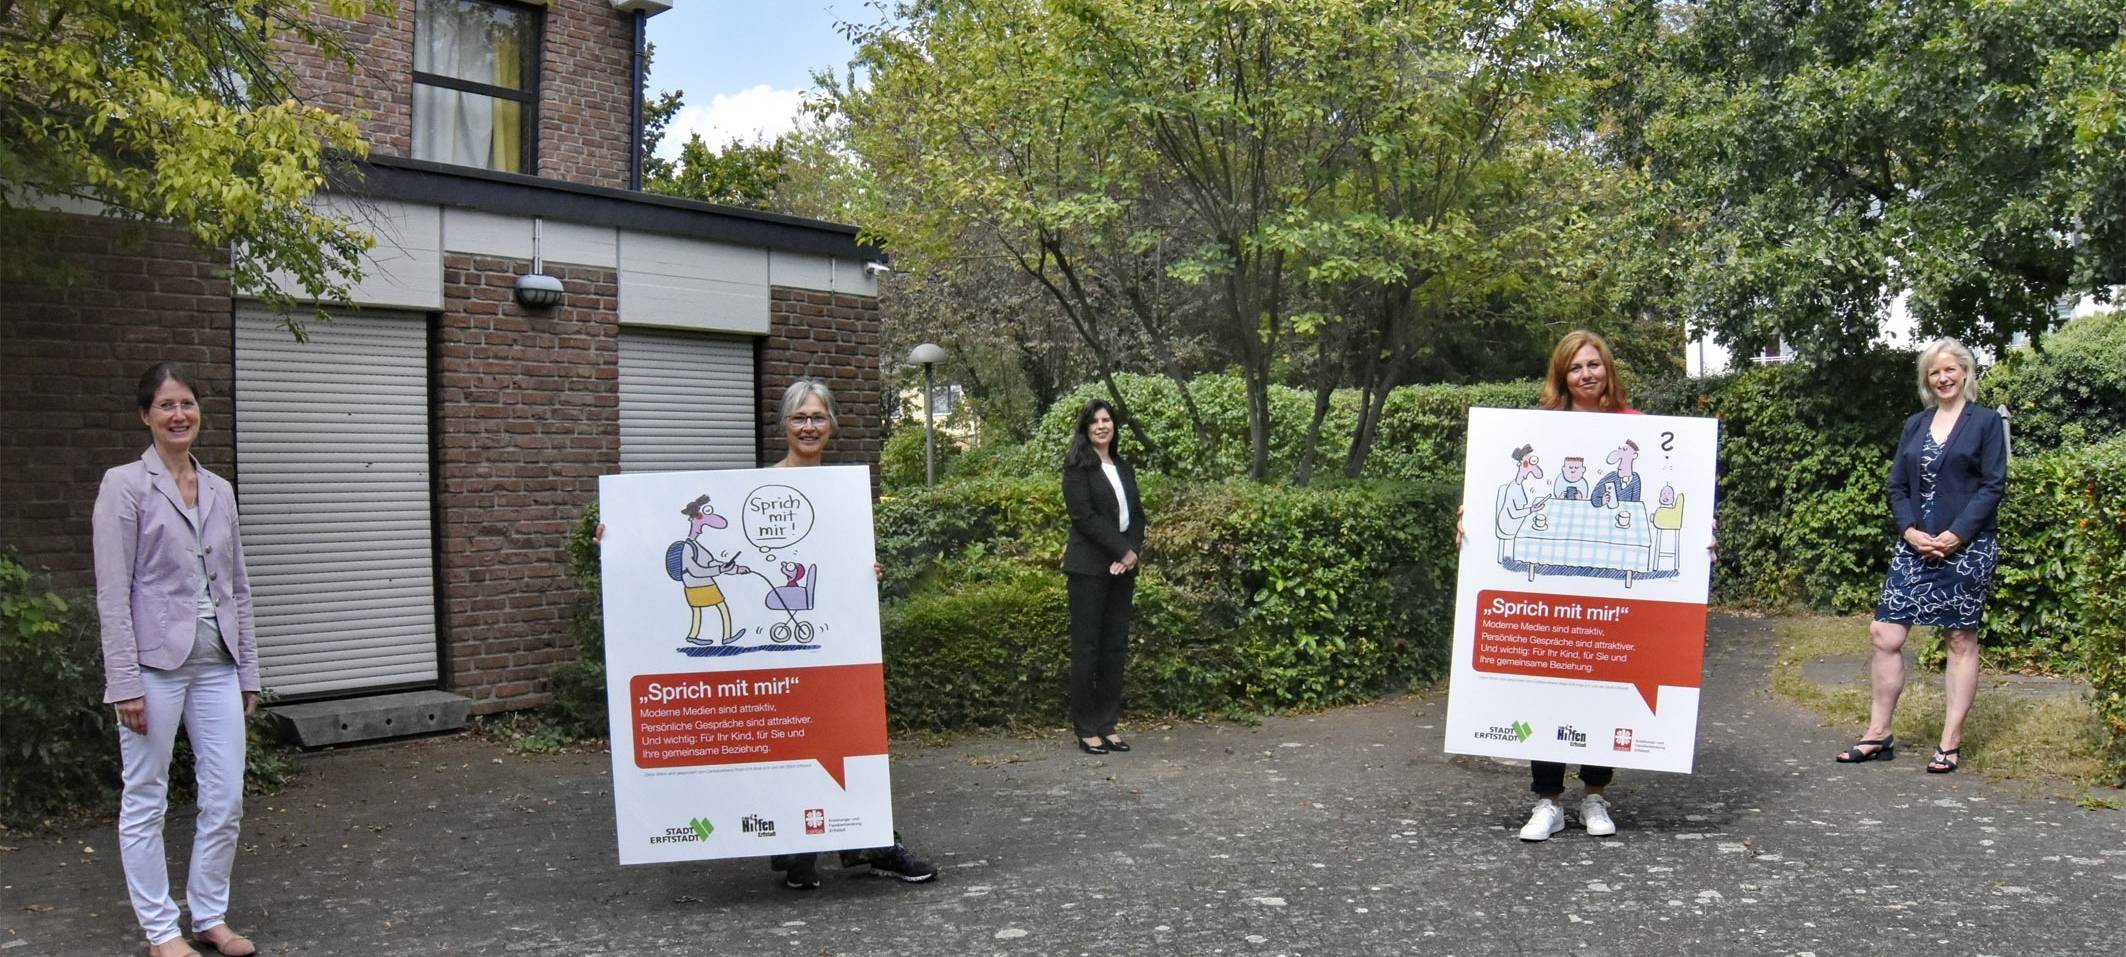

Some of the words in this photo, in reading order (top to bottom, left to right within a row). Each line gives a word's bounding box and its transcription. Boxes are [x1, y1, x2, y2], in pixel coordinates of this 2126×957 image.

[750, 494, 800, 514] Sprich
[769, 510, 796, 522] mit
[1554, 603, 1581, 619] mit
[1483, 620, 1518, 630] Moderne
[1520, 623, 1550, 632] Medien
[1552, 624, 1569, 634] sind
[1571, 626, 1605, 636] attraktiv,
[1482, 633, 1527, 643] Persönliche
[1530, 636, 1573, 648] Gespräche
[1576, 639, 1592, 649] sind
[1595, 641, 1636, 651] attraktiver.
[1481, 645, 1498, 653] Und
[1500, 646, 1529, 657] wichtig:
[1533, 648, 1545, 656] Für
[1548, 649, 1557, 657] Ihr
[1583, 651, 1594, 660] für
[1596, 652, 1608, 661] Sie
[1611, 654, 1627, 662] und
[1480, 656, 1494, 664] Ihre
[1497, 658, 1548, 668] gemeinsame
[1550, 660, 1594, 673] Beziehung.
[718, 679, 748, 696] mit
[640, 707, 680, 718] Moderne
[683, 706, 716, 716] Medien
[719, 704, 737, 713] sind
[739, 703, 777, 713] attraktiv,
[641, 721, 692, 732] Persönliche
[695, 719, 743, 731] Gespräche
[746, 717, 765, 727] sind
[767, 715, 812, 726] attraktiver.
[1490, 726, 1514, 734] STADT
[642, 736, 661, 746] Und
[663, 734, 697, 746] wichtig:
[700, 732, 715, 742] Für
[717, 732, 728, 741] Ihr
[757, 730, 767, 739] für
[771, 728, 785, 738] Sie
[788, 727, 805, 737] und
[1474, 732, 1518, 741] ERFTSTADT
[643, 748, 659, 758] Ihre
[662, 747, 719, 760] gemeinsame
[722, 744, 771, 755] Beziehung.
[666, 827, 693, 835] STADT
[742, 814, 774, 833] Hilfen
[650, 835, 699, 844] ERFTSTADT
